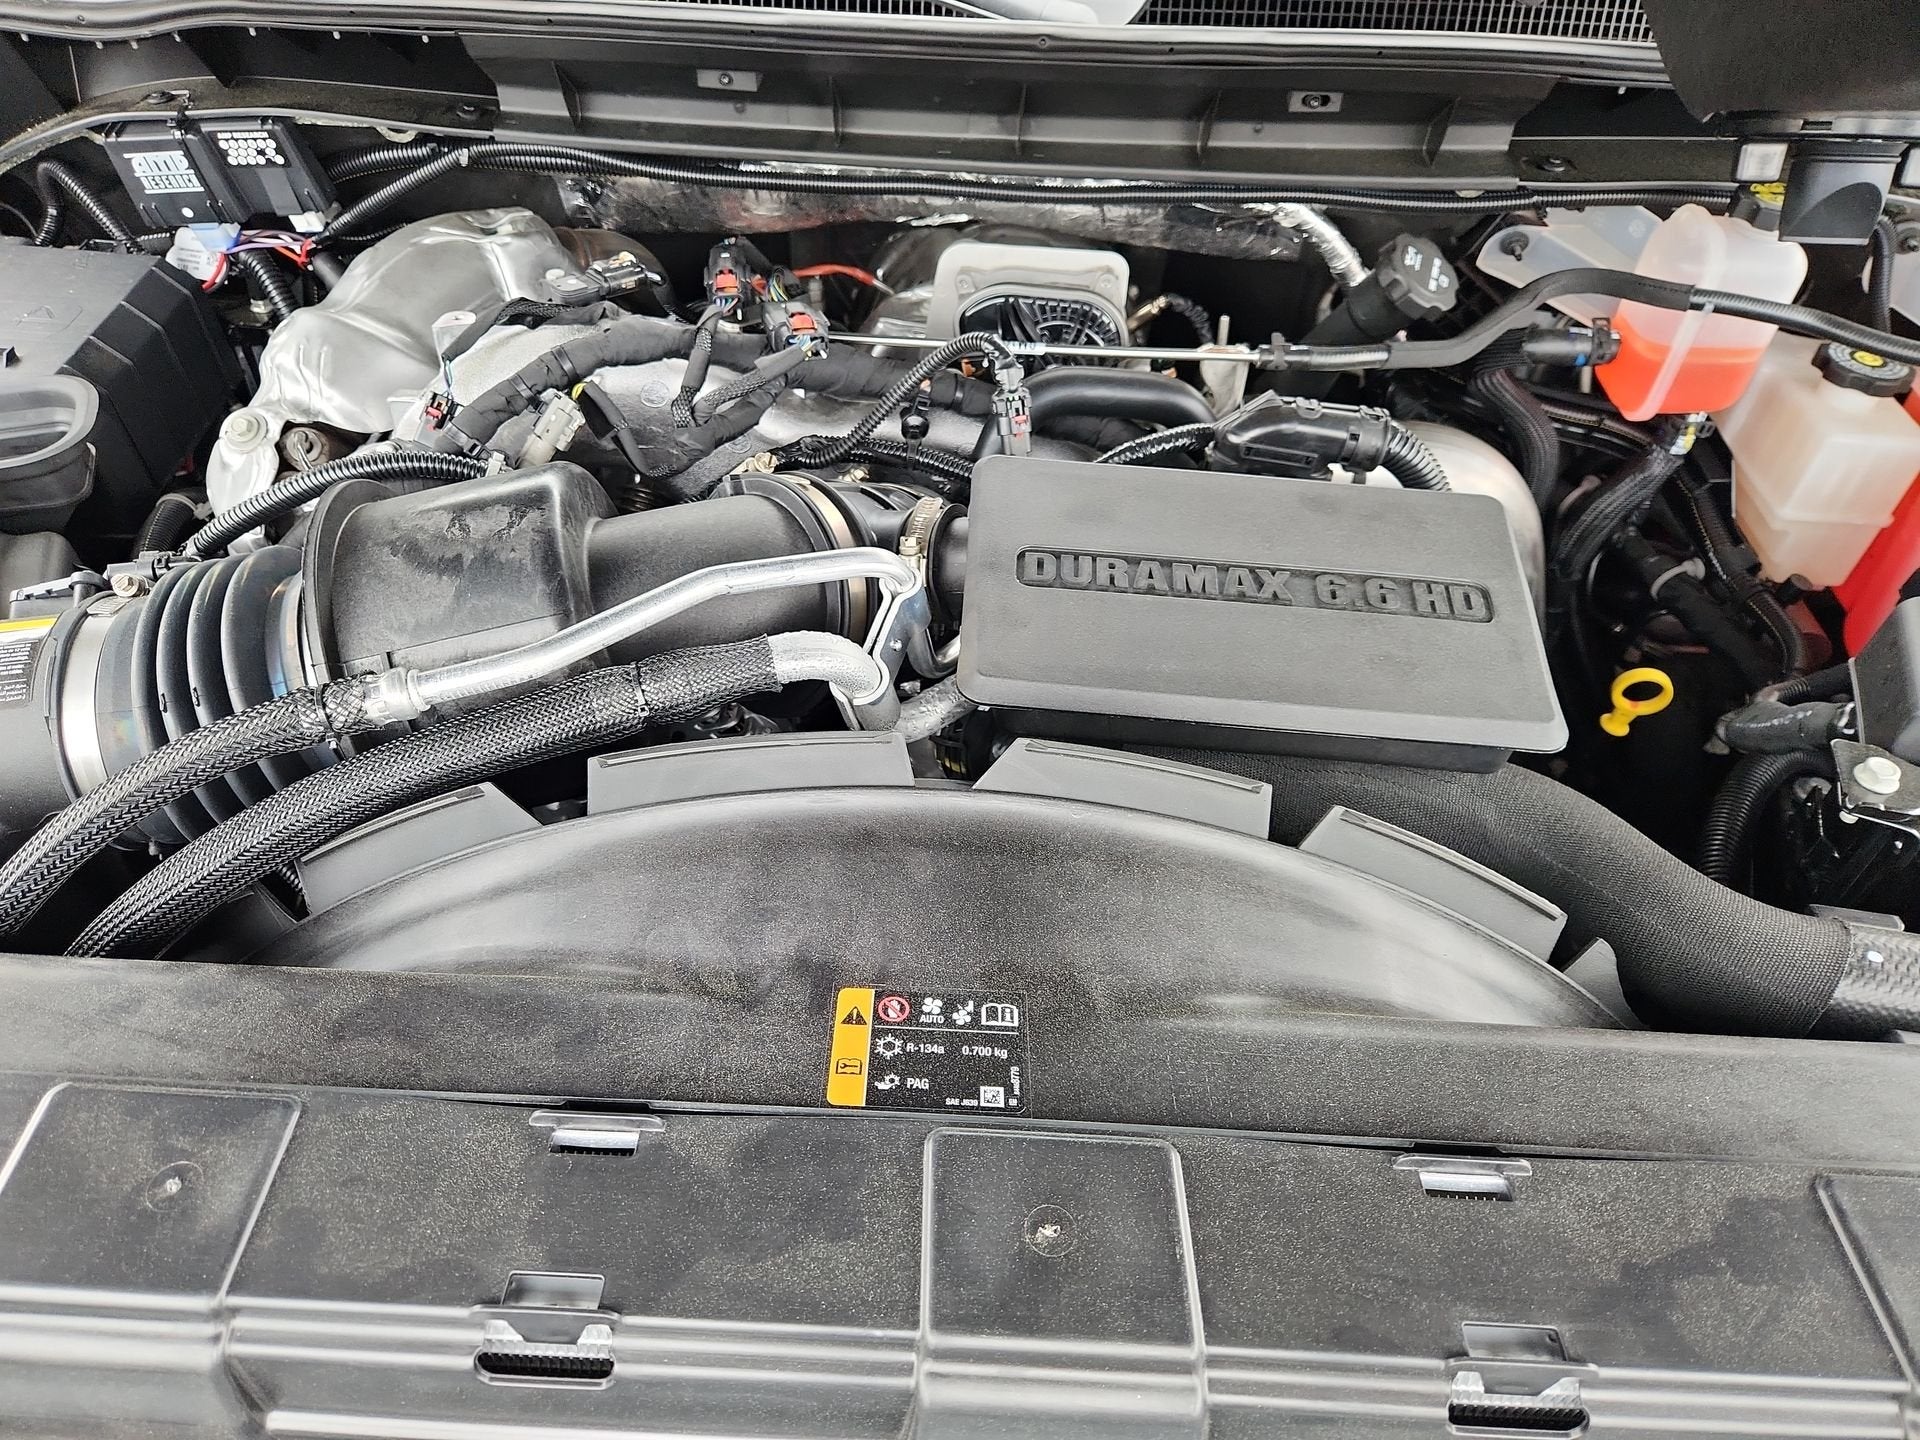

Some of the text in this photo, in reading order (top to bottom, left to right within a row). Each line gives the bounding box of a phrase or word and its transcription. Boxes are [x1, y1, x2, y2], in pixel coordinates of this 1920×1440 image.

[140, 174, 201, 190] RESEARCH
[1024, 552, 1488, 618] DURAMAX 6.6 HD
[919, 1014, 945, 1024] AUTO
[905, 1042, 946, 1055] R-134a
[962, 1045, 1009, 1059] 0.700 kg
[906, 1077, 930, 1090] PAG
[945, 1097, 960, 1106] SAE
